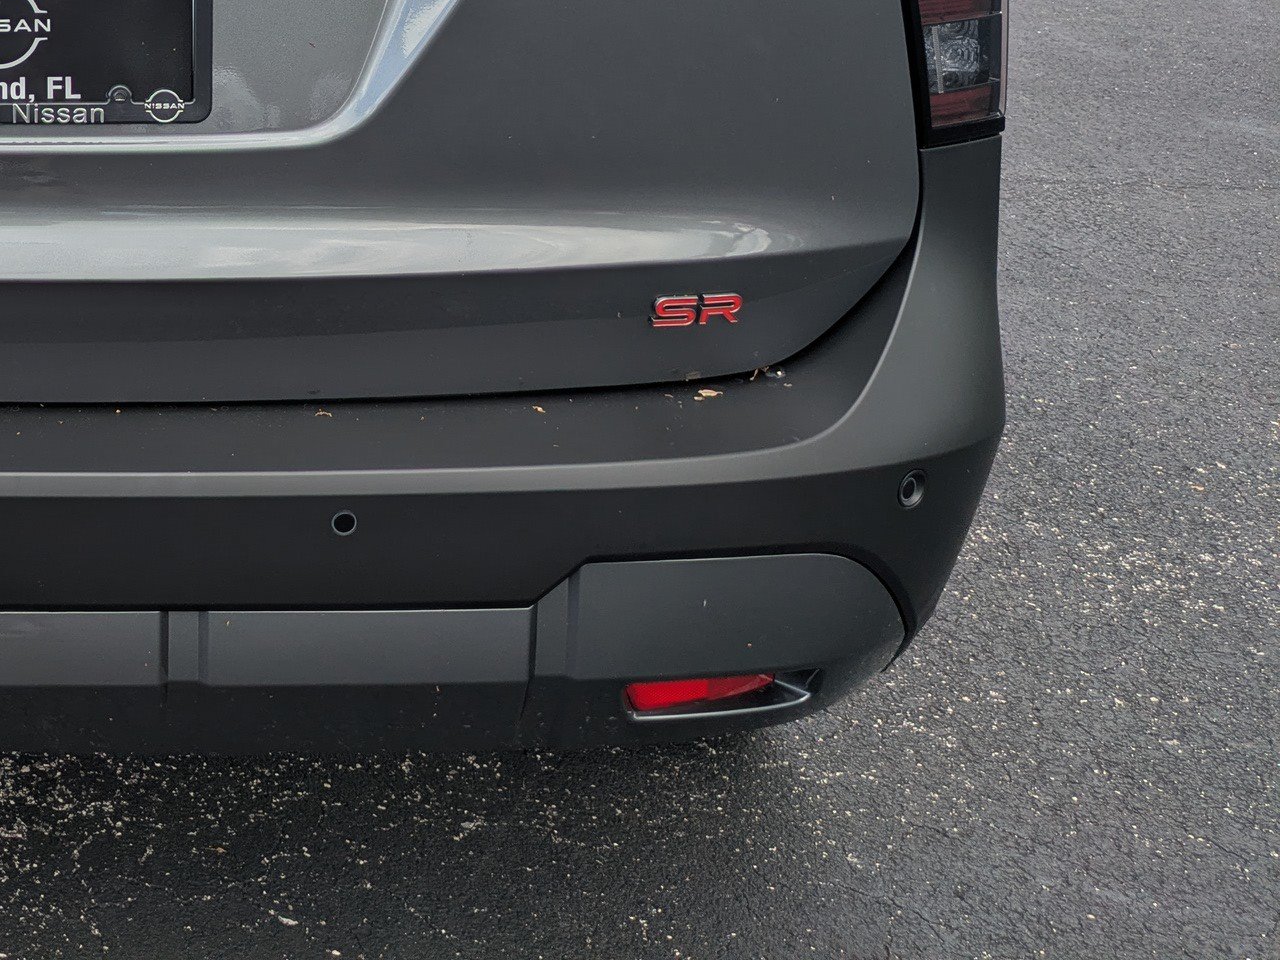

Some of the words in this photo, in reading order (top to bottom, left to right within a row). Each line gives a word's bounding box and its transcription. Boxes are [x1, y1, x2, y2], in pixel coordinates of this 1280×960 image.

[46, 76, 81, 100] FL
[12, 102, 105, 124] Nissan
[144, 101, 185, 110] NISSAN
[650, 291, 743, 327] SR
